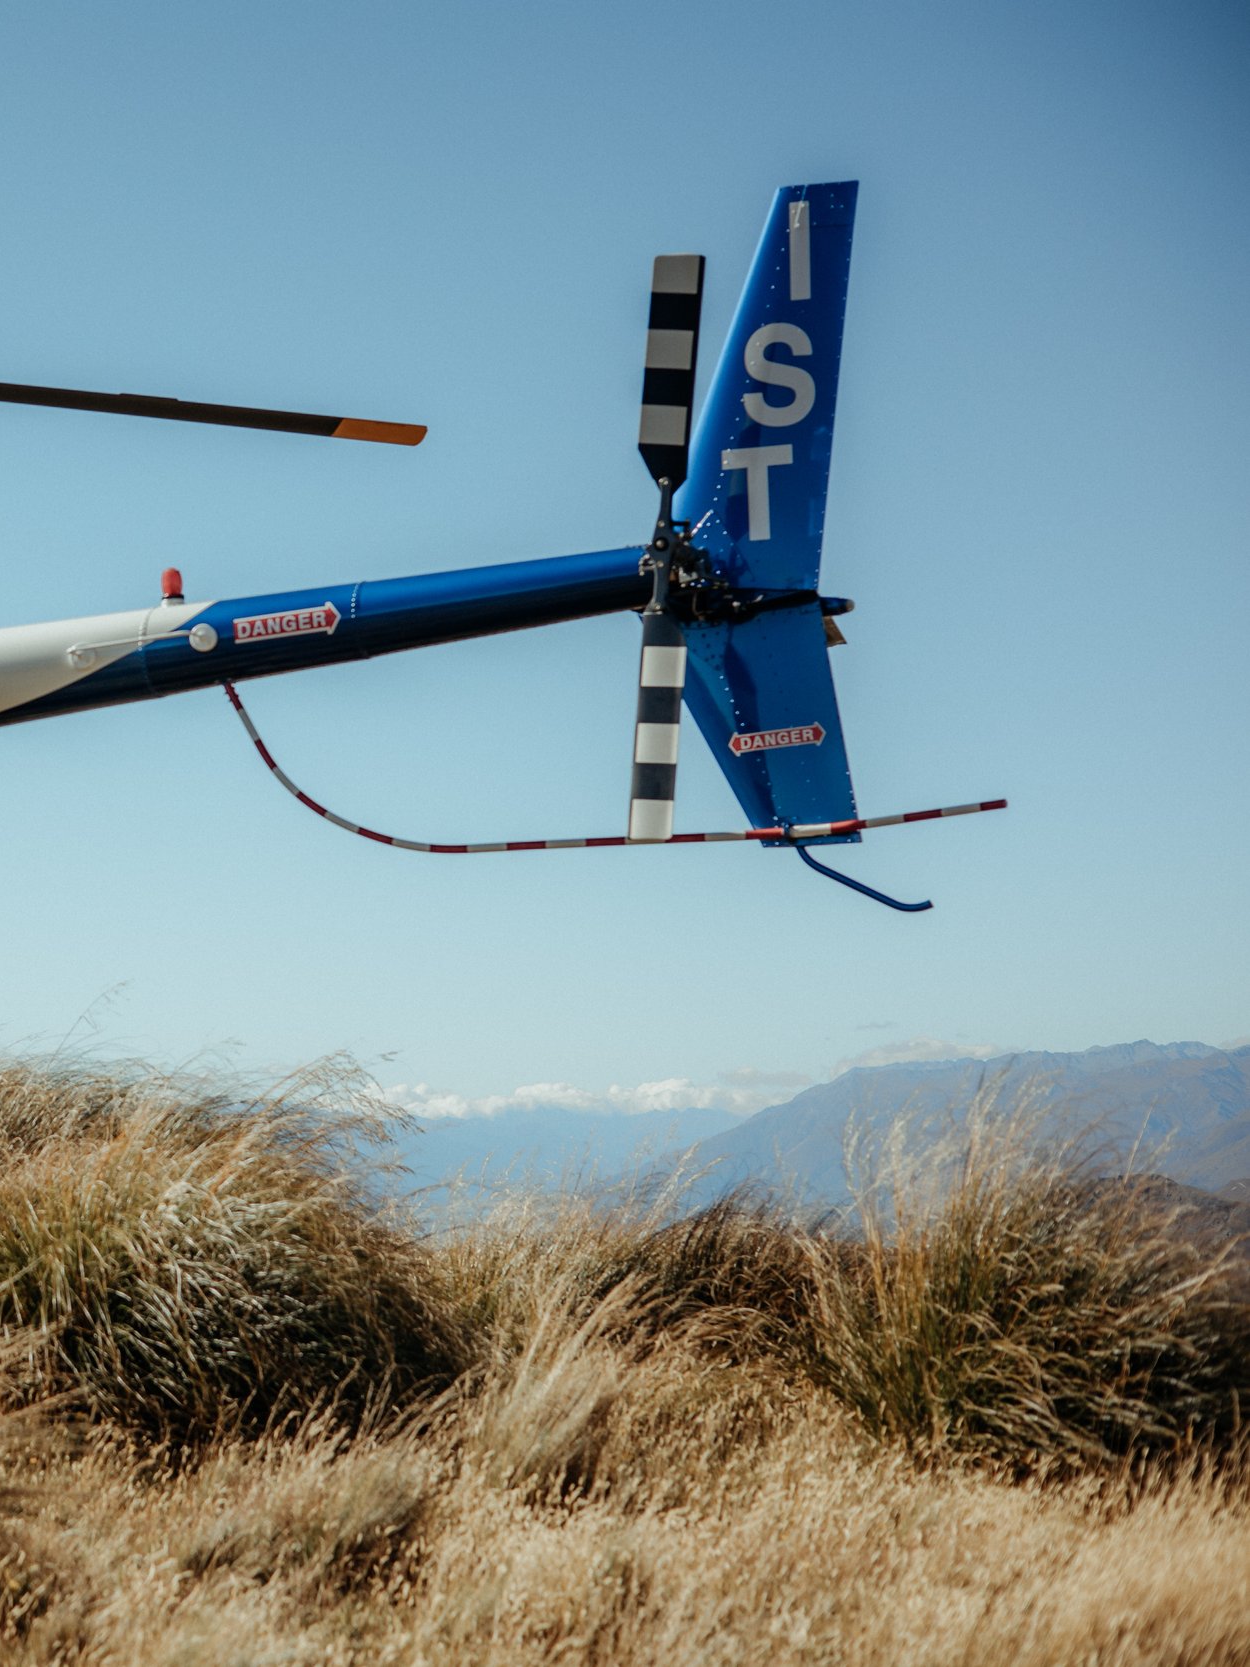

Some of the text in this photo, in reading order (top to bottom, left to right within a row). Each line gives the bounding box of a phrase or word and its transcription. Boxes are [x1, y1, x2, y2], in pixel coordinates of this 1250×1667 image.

[721, 200, 816, 541] IST
[237, 611, 327, 639] DANGER
[740, 729, 815, 750] DANGER
